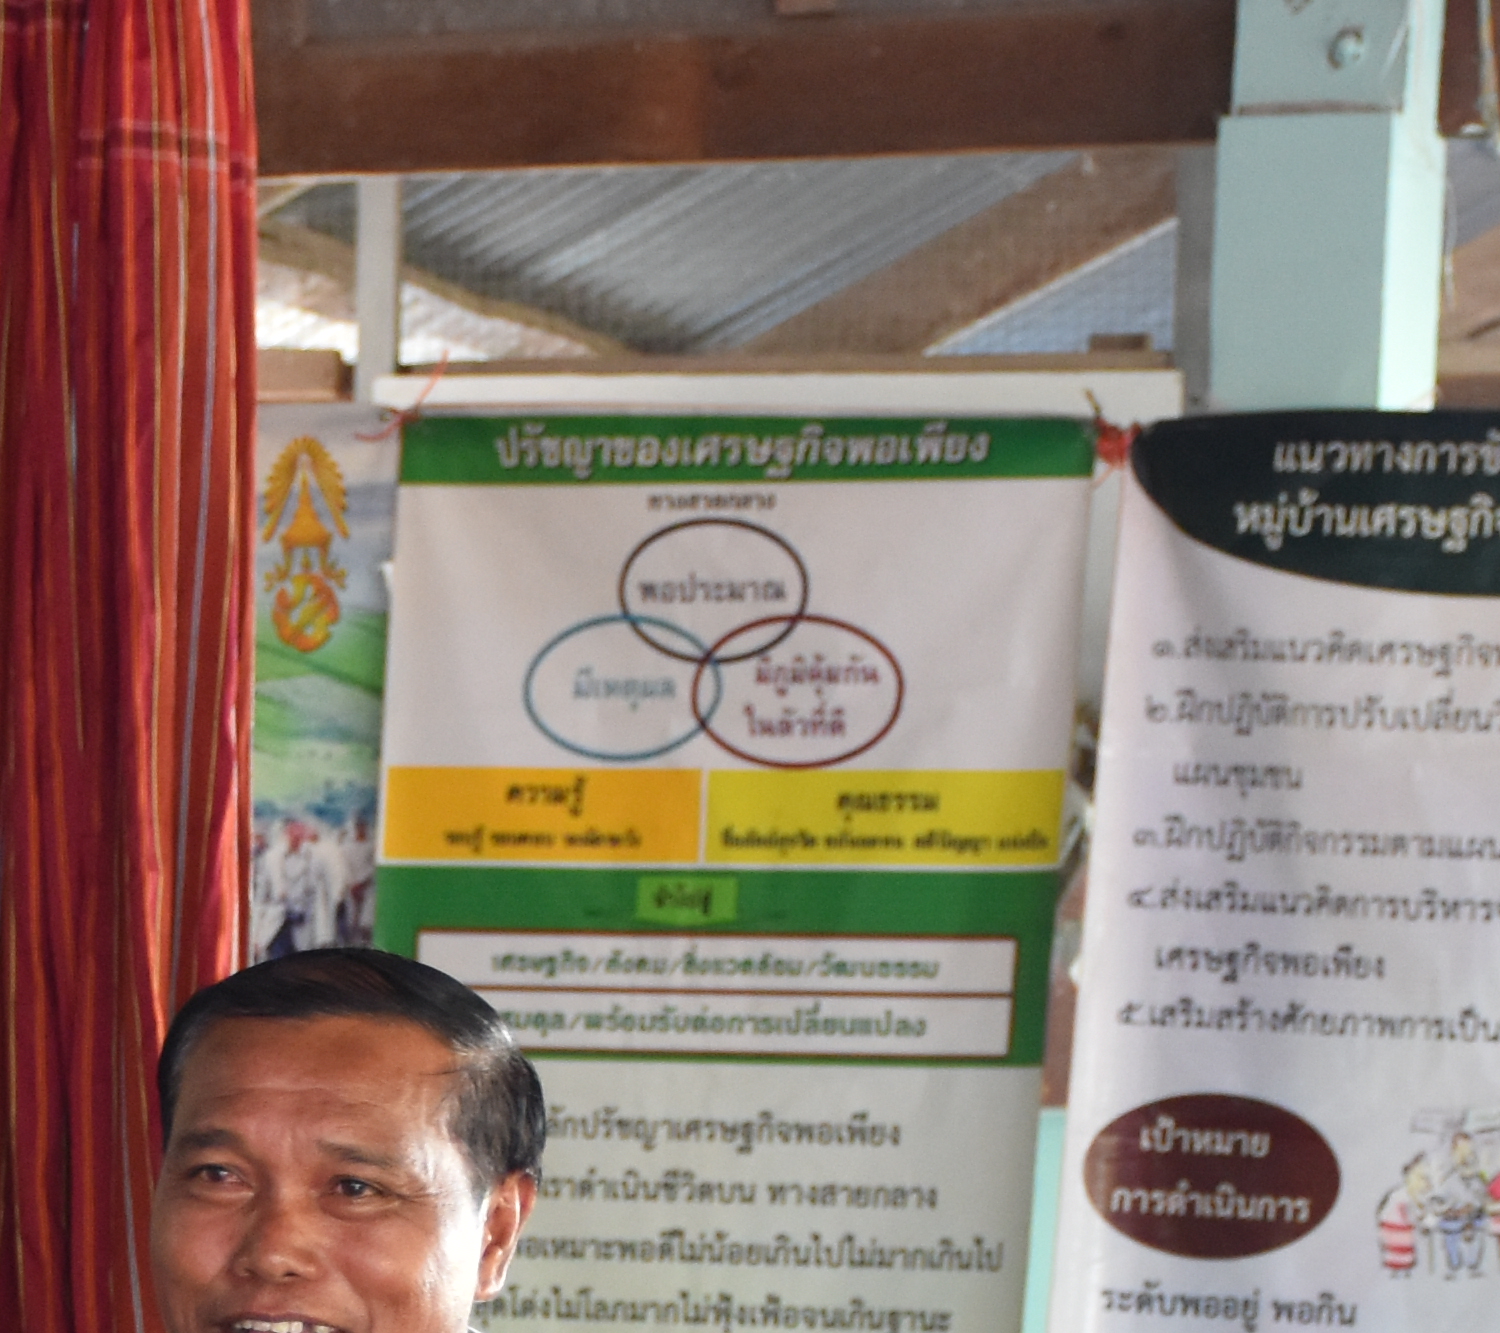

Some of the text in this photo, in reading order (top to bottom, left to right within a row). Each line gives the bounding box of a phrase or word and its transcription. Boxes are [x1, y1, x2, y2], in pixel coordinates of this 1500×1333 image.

[493, 420, 990, 480] ปรัชญาของเศรษฐกิจพอเพียง
[637, 576, 788, 607] พอประมาณ
[1172, 758, 1303, 800] แผนชุมชน
[1154, 942, 1387, 986] เศรษฐกิจพอเพียง
[1138, 1115, 1270, 1158] เป้าหมาย
[1110, 1180, 1311, 1224] การดำเนินการ
[1271, 1289, 1359, 1328] พอกิน
